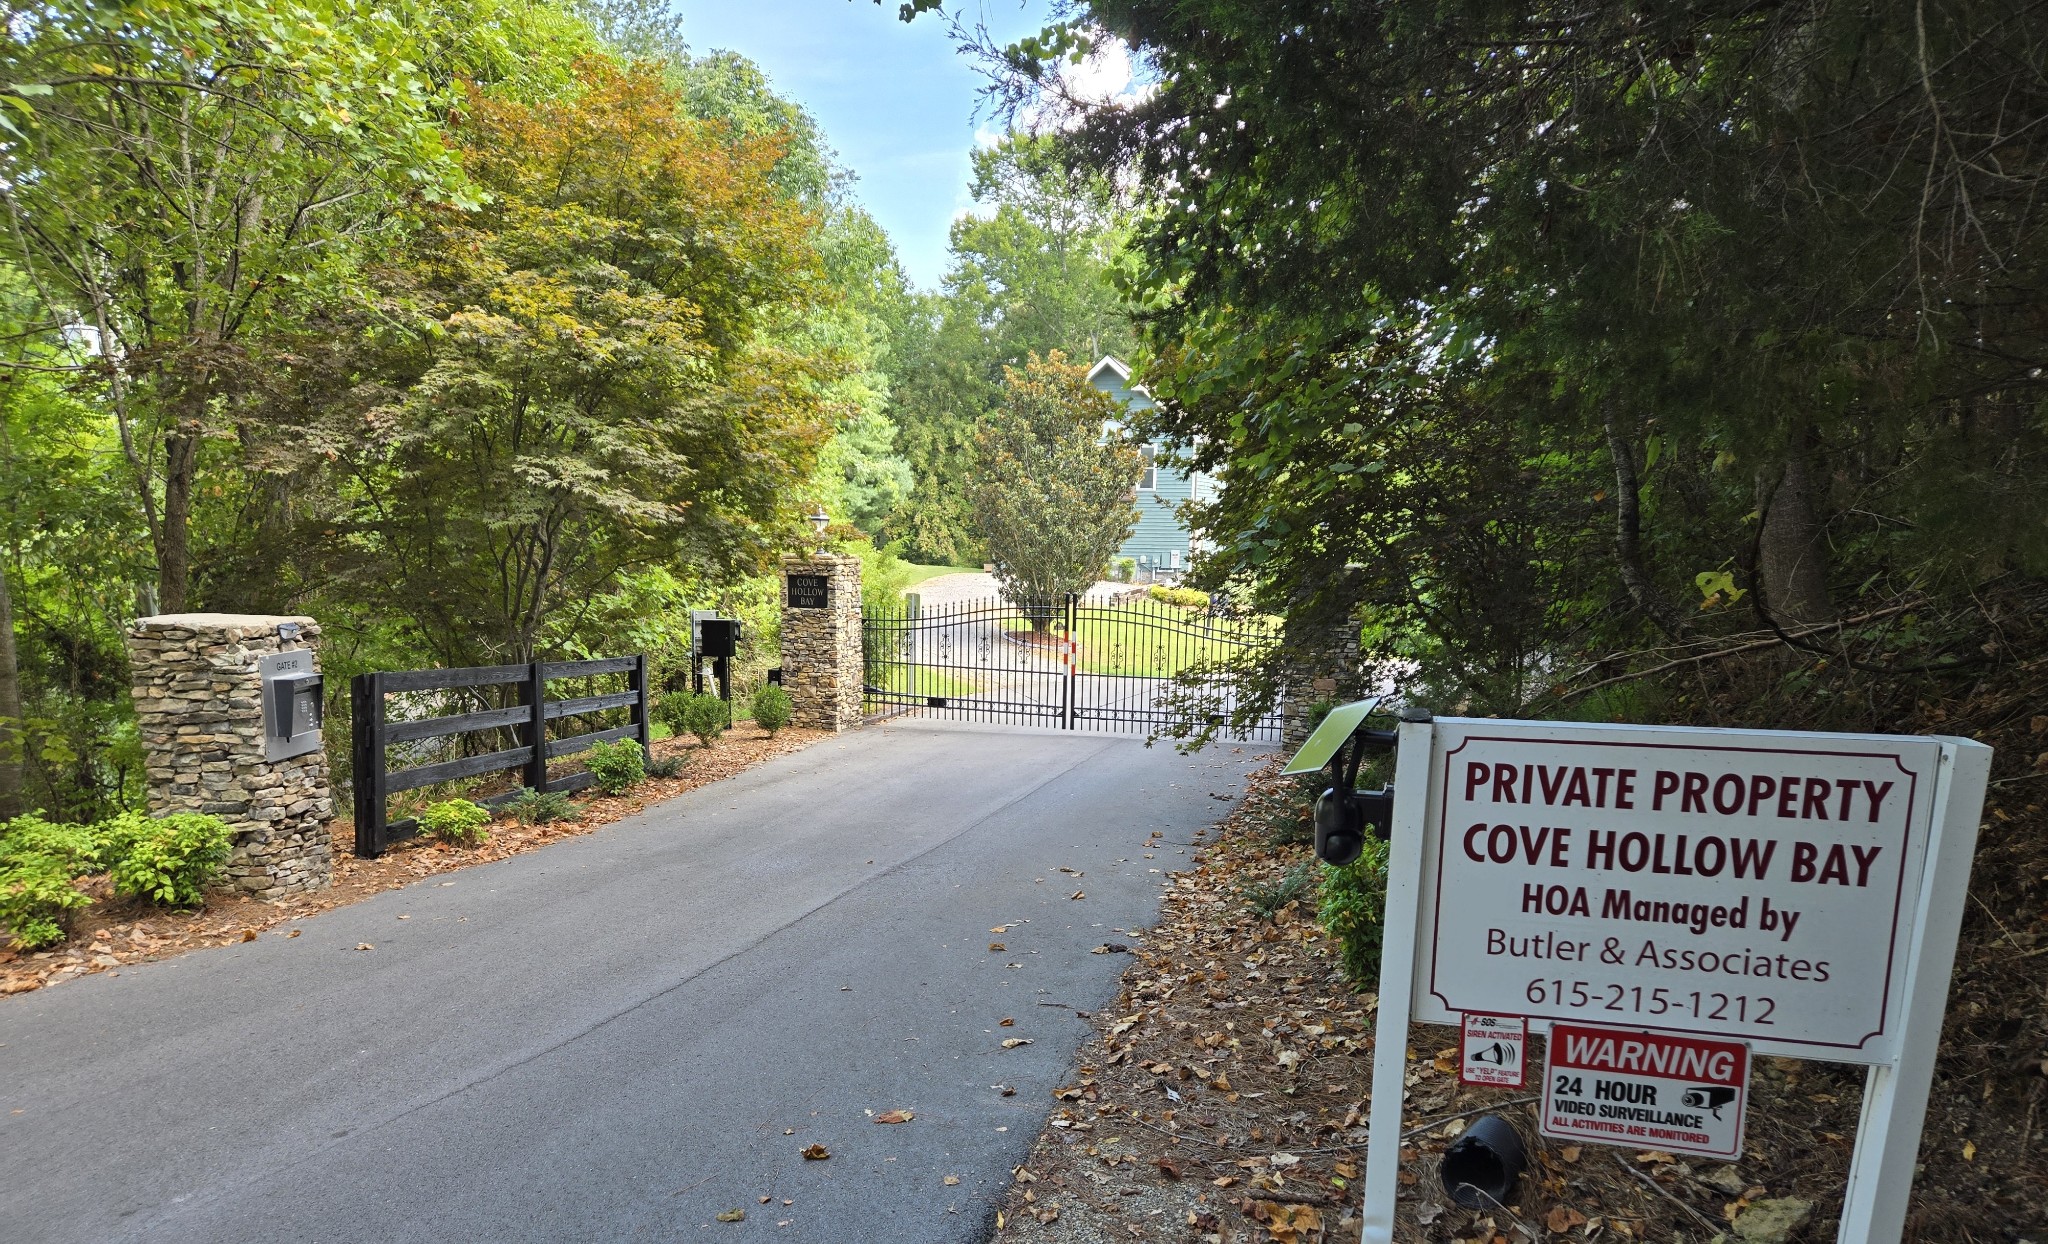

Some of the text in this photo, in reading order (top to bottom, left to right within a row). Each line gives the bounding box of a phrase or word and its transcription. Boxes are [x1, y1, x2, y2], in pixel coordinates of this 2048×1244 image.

[791, 587, 824, 596] HOLLOW
[797, 578, 818, 587] COVE
[800, 597, 815, 606] BAY
[276, 660, 291, 671] GATE
[1464, 761, 1895, 824] PRIVATE PROPERTY
[1462, 822, 1884, 889] COVE HOLLOW BAY
[1521, 882, 1801, 942] HOA Managed by
[1486, 927, 1832, 984] Butler & Associates
[1525, 977, 1777, 1026] 615-215-1212
[1467, 1029, 1522, 1041] SIREN ACTIVATED
[1480, 1017, 1497, 1027] SOS
[1566, 1034, 1735, 1082] WARNING
[1555, 1075, 1657, 1106] 24 HOUR
[1554, 1099, 1703, 1129] VIDEO SURVEILLANCE
[1552, 1116, 1710, 1144] ALL ACTIVITIES ARE MONITORED
